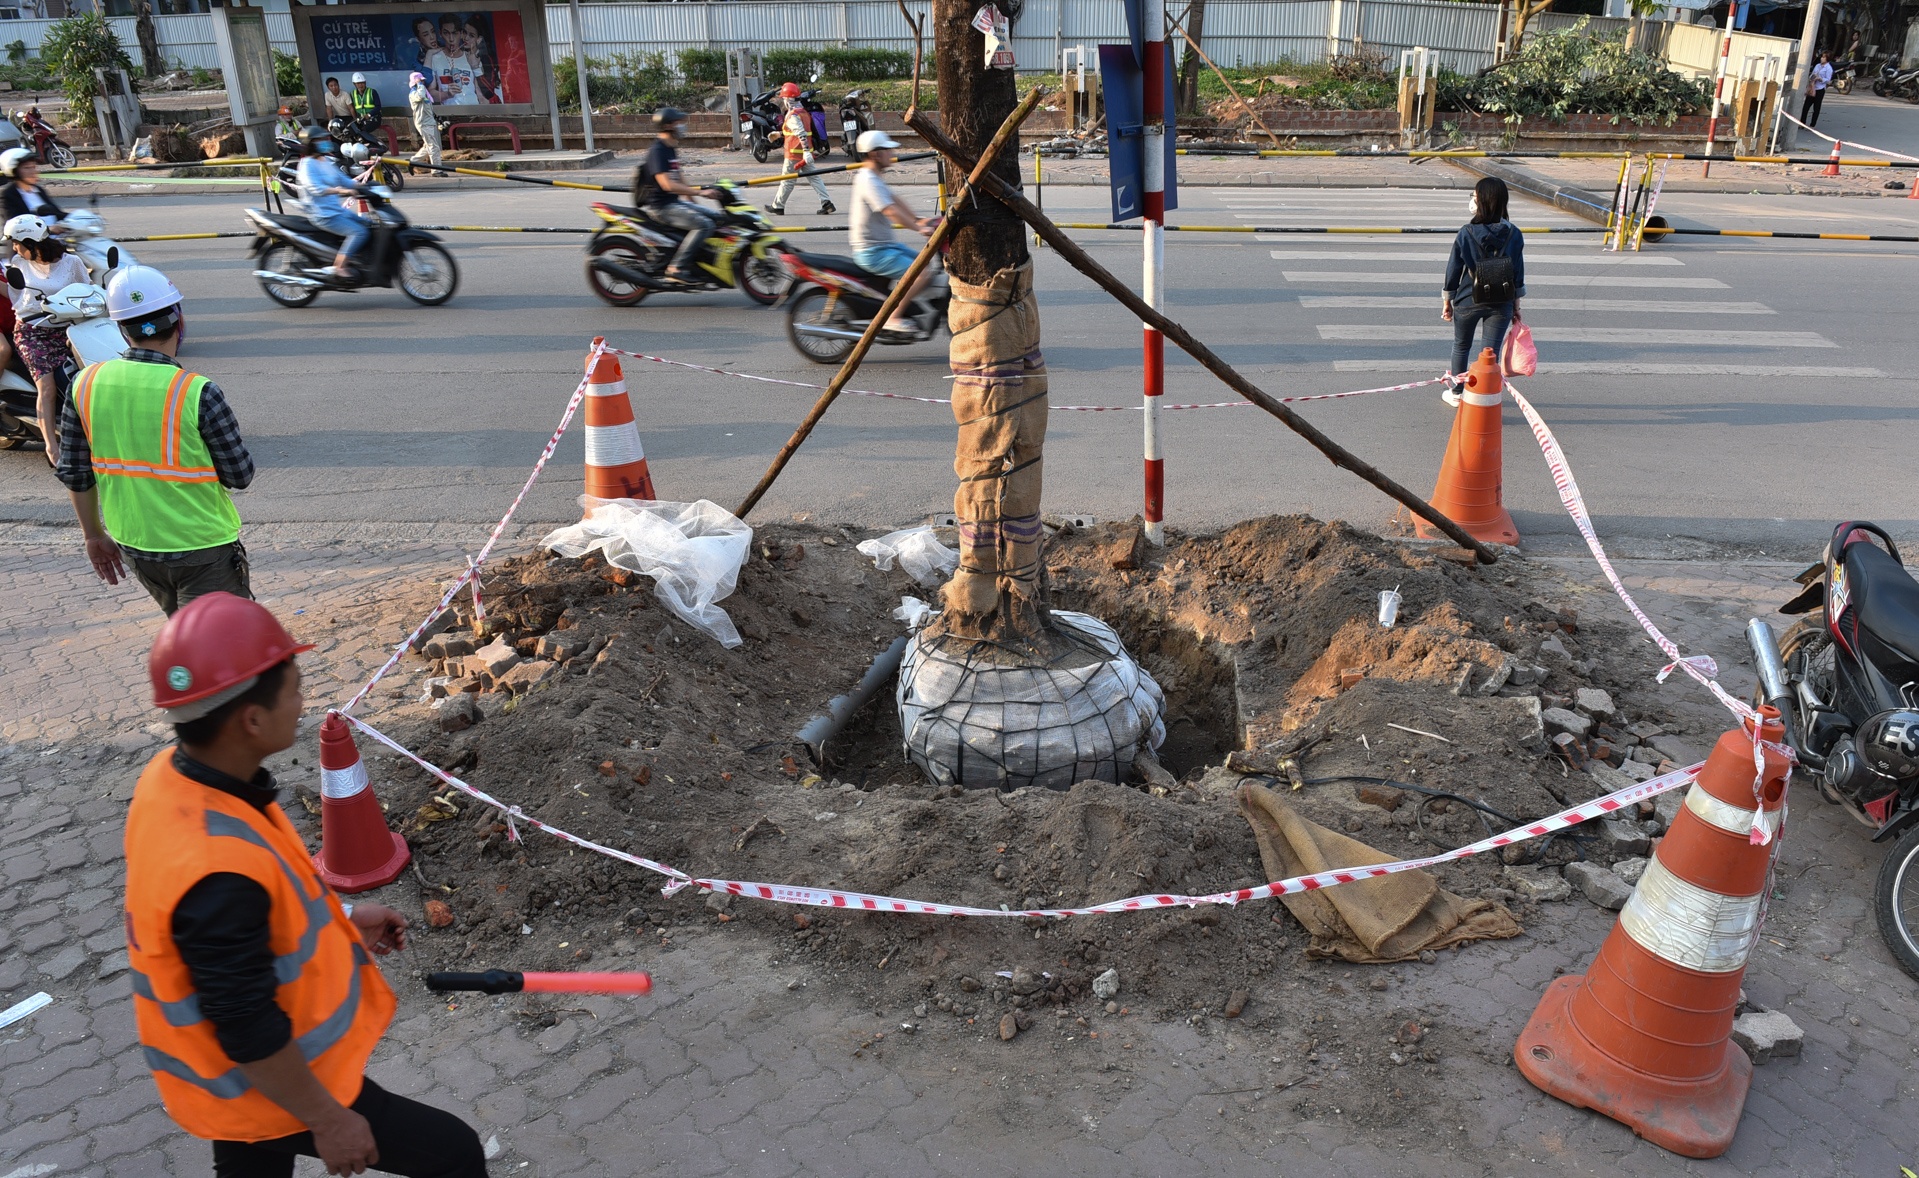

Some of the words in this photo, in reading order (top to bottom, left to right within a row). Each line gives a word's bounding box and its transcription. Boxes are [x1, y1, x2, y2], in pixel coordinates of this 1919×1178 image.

[322, 20, 341, 34] CỨ
[343, 18, 372, 34] TRẺ.
[325, 35, 344, 50] CỨ
[327, 51, 347, 65] CỨ
[349, 51, 389, 64] PEPSI.
[443, 68, 471, 77] PPSI
